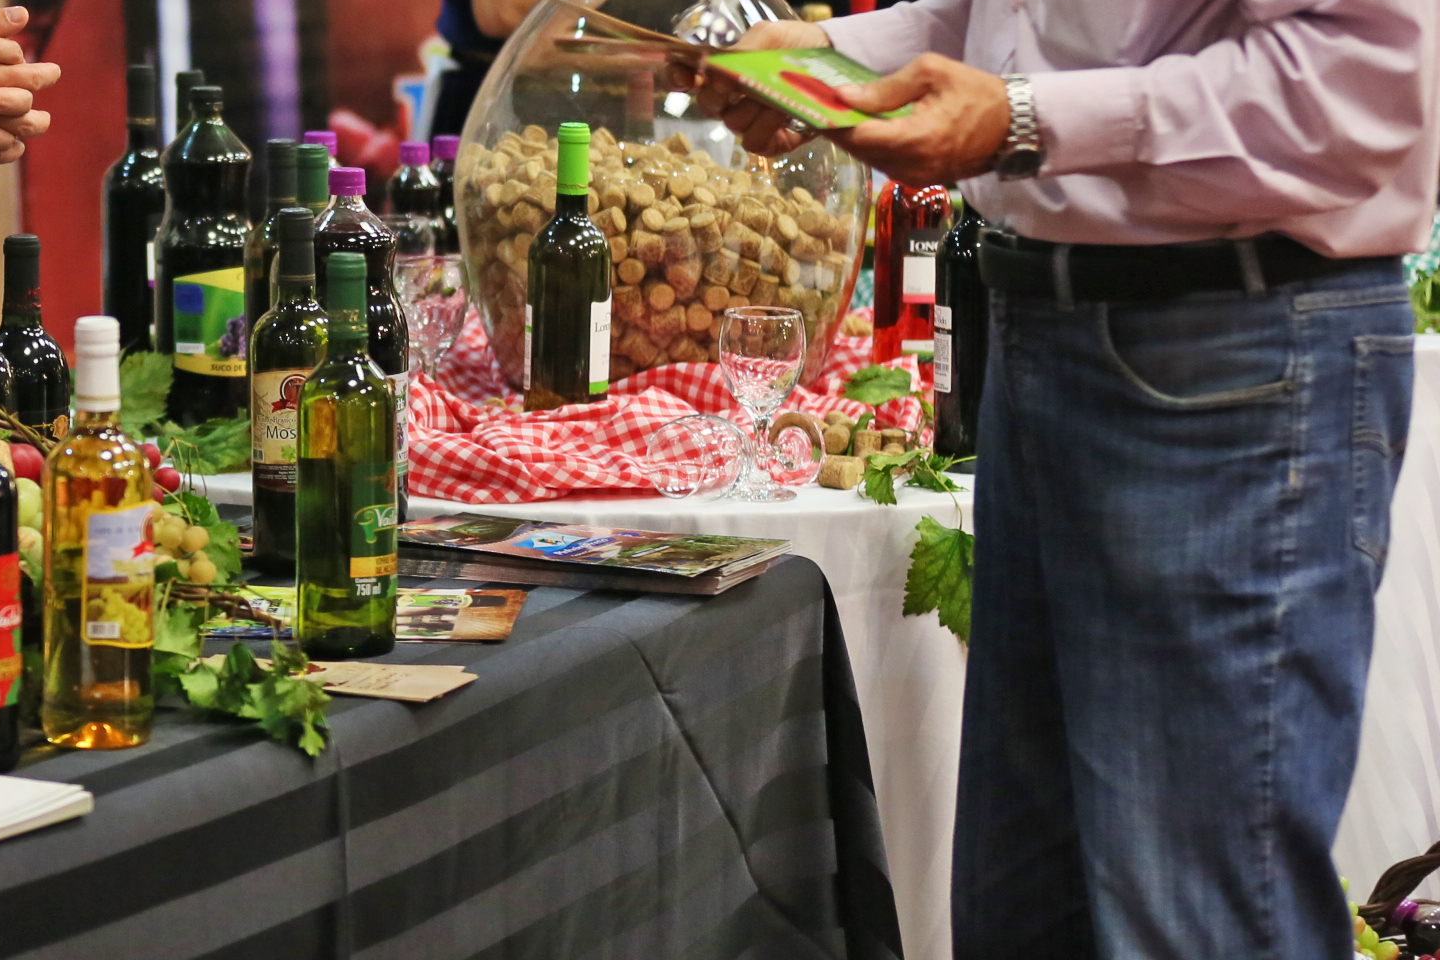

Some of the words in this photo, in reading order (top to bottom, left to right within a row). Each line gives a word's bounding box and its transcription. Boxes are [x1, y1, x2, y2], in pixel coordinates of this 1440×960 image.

[210, 363, 231, 372] SUCO
[266, 425, 298, 440] Mos
[355, 583, 371, 596] 750
[372, 582, 382, 595] ml
